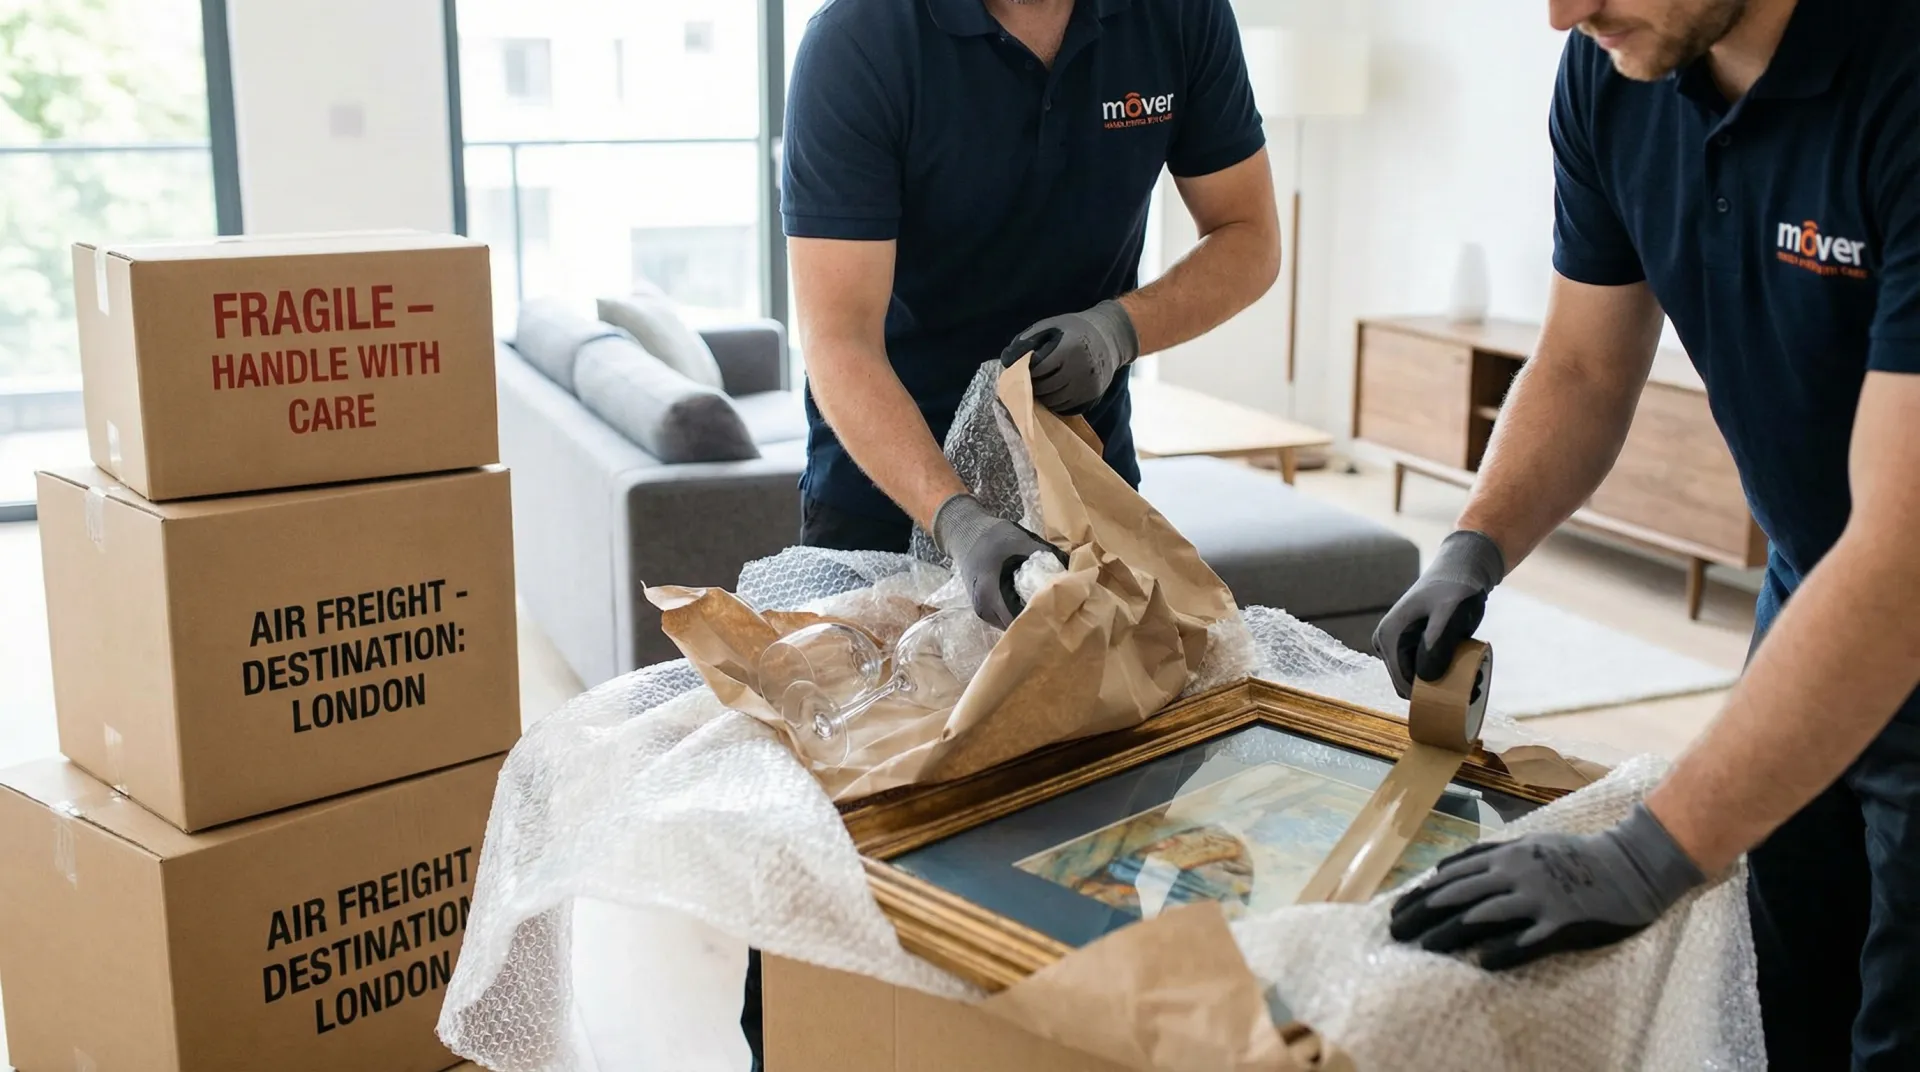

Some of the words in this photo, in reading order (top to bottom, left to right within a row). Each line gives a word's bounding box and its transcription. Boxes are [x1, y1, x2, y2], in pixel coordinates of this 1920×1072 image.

[213, 284, 396, 339] FRAGILE
[211, 346, 349, 391] HANDLE
[357, 340, 441, 379] WITH
[288, 393, 377, 435] CARE
[249, 605, 307, 648] AIR
[316, 578, 447, 635] FREIGHT
[242, 621, 466, 697] DESTINATION:
[292, 672, 427, 734] LONDON
[266, 898, 328, 952] AIR
[338, 846, 473, 925] FREIGHT
[314, 950, 452, 1036] LONDON
